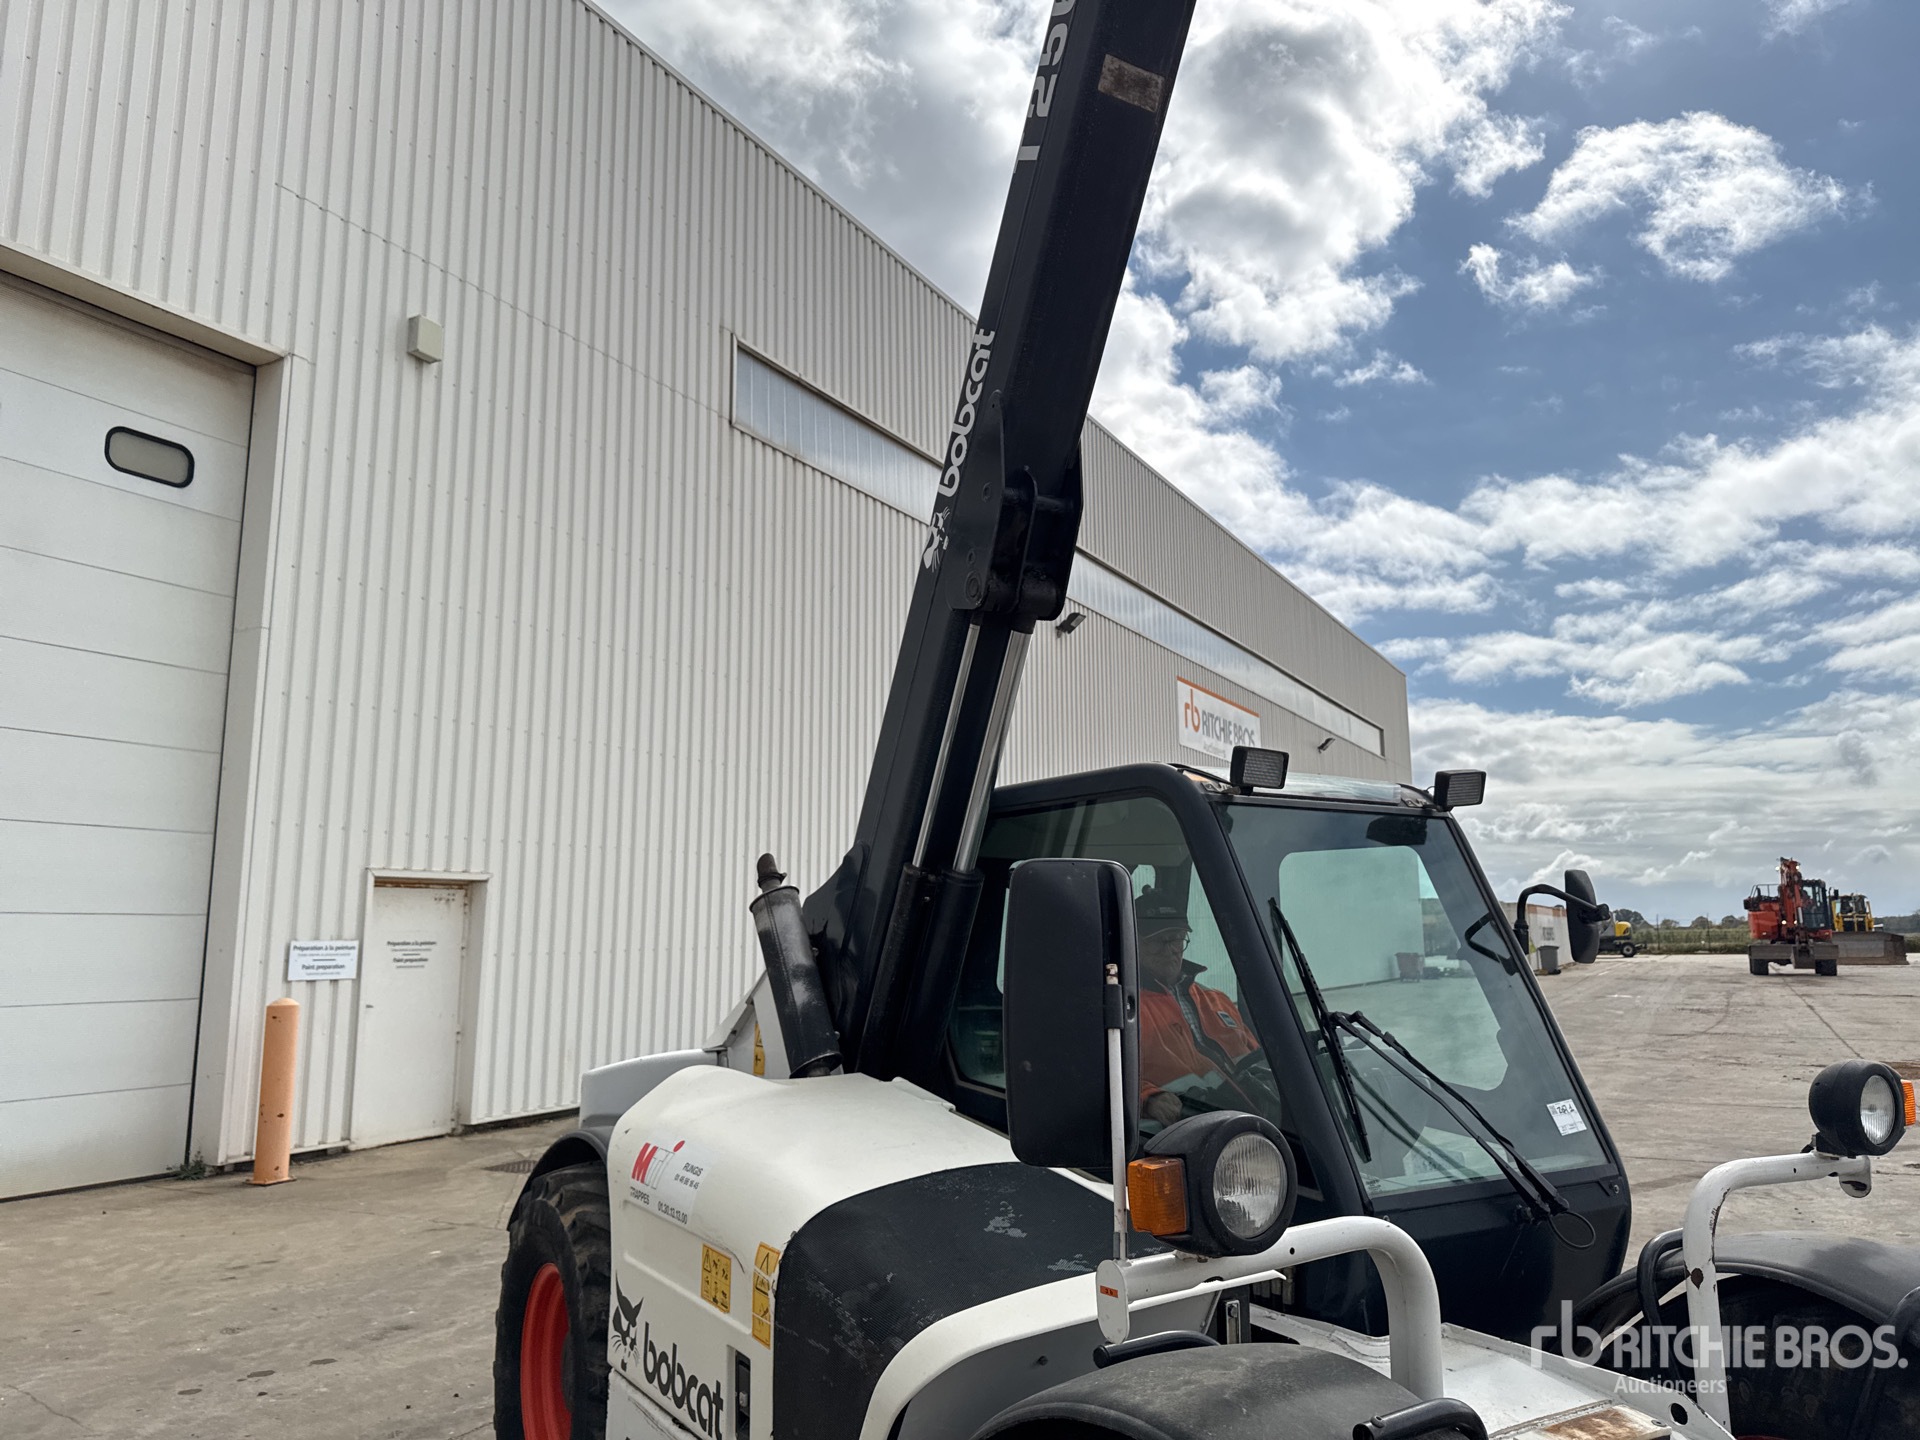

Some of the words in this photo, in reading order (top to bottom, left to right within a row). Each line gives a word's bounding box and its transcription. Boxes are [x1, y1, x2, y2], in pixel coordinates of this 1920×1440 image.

[939, 328, 996, 498] bobcat
[1201, 710, 1233, 745] RITCHIE
[643, 1321, 724, 1440] bobcat
